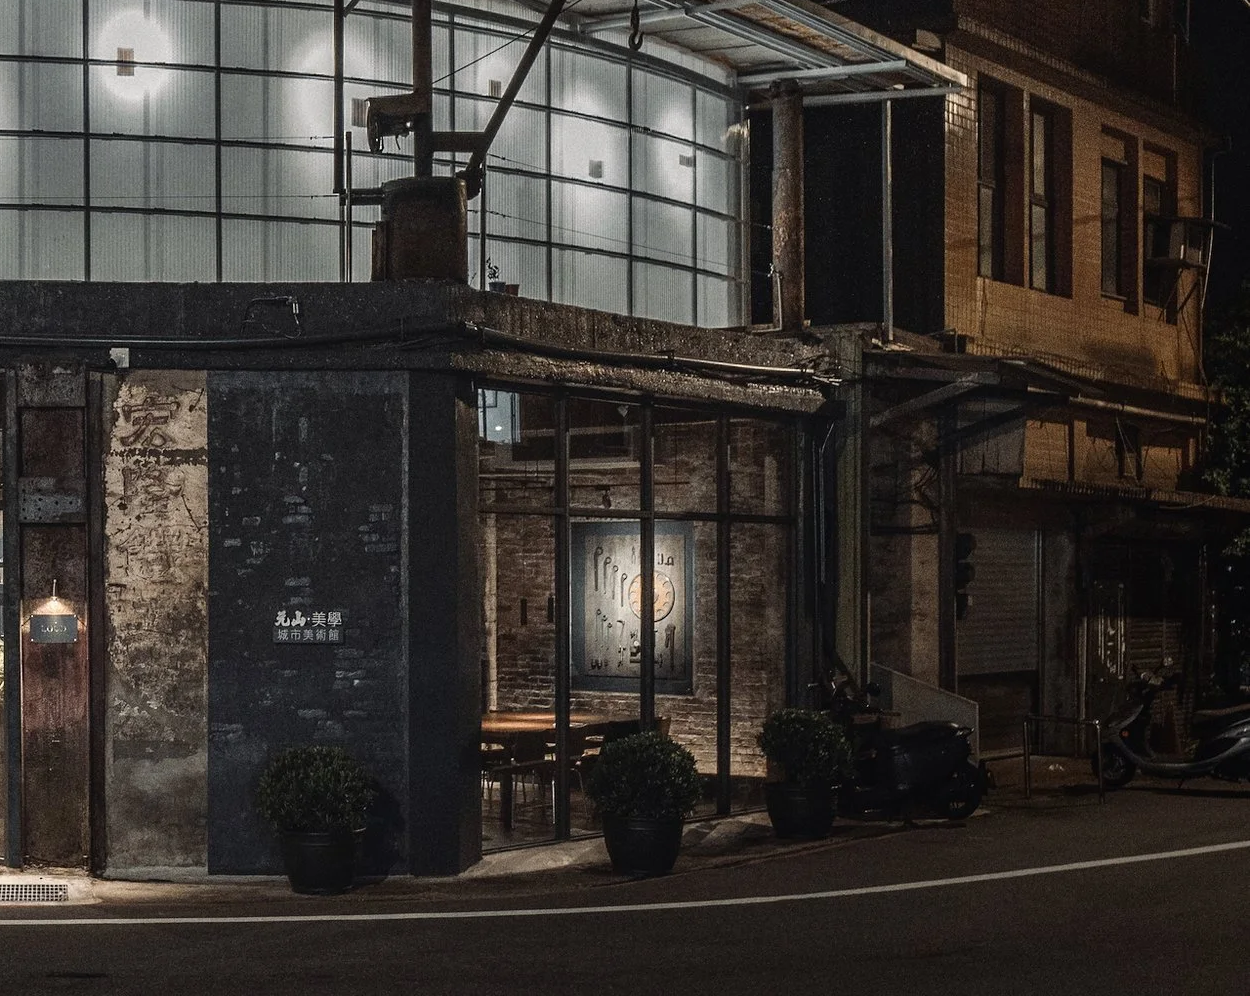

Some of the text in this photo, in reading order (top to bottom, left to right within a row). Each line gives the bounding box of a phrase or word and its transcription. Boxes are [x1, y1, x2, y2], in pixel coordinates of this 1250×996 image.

[277, 628, 340, 641] 城市美術館
